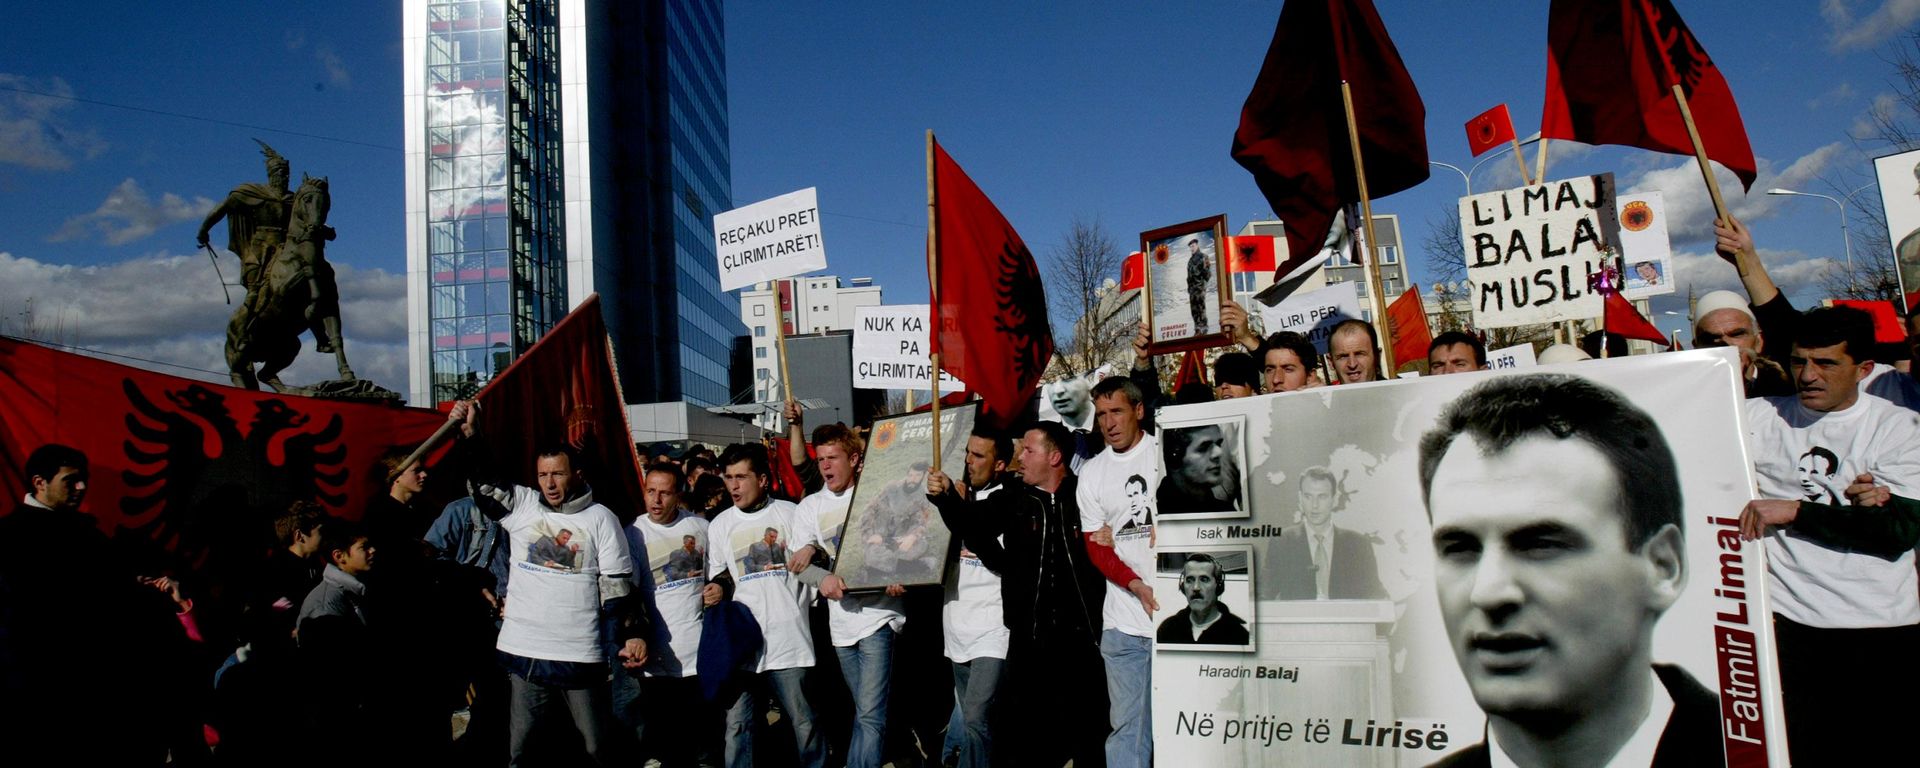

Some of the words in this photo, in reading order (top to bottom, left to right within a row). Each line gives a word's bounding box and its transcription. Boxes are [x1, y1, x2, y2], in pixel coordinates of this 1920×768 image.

[720, 218, 775, 246] REÇAKU
[778, 208, 816, 230] PRET
[723, 233, 819, 273] ÇLIRIMTARËT!
[864, 317, 895, 332] NUK
[902, 317, 923, 332] KA
[1280, 314, 1305, 329] LIRI
[1310, 306, 1338, 322] PËR
[900, 340, 920, 355] PA
[903, 413, 957, 429] KOMANANT
[901, 422, 954, 442] ÇERÇZI
[1196, 526, 1223, 539] Isak
[1227, 525, 1282, 538] Musliu
[1199, 665, 1251, 678] Haradin
[1256, 666, 1299, 683] Balaj
[1719, 633, 1761, 745] Fatmir
[1176, 711, 1214, 737] Në
[1223, 715, 1293, 747] pritje
[1304, 719, 1330, 743] të
[1342, 719, 1449, 750] Lirisë
